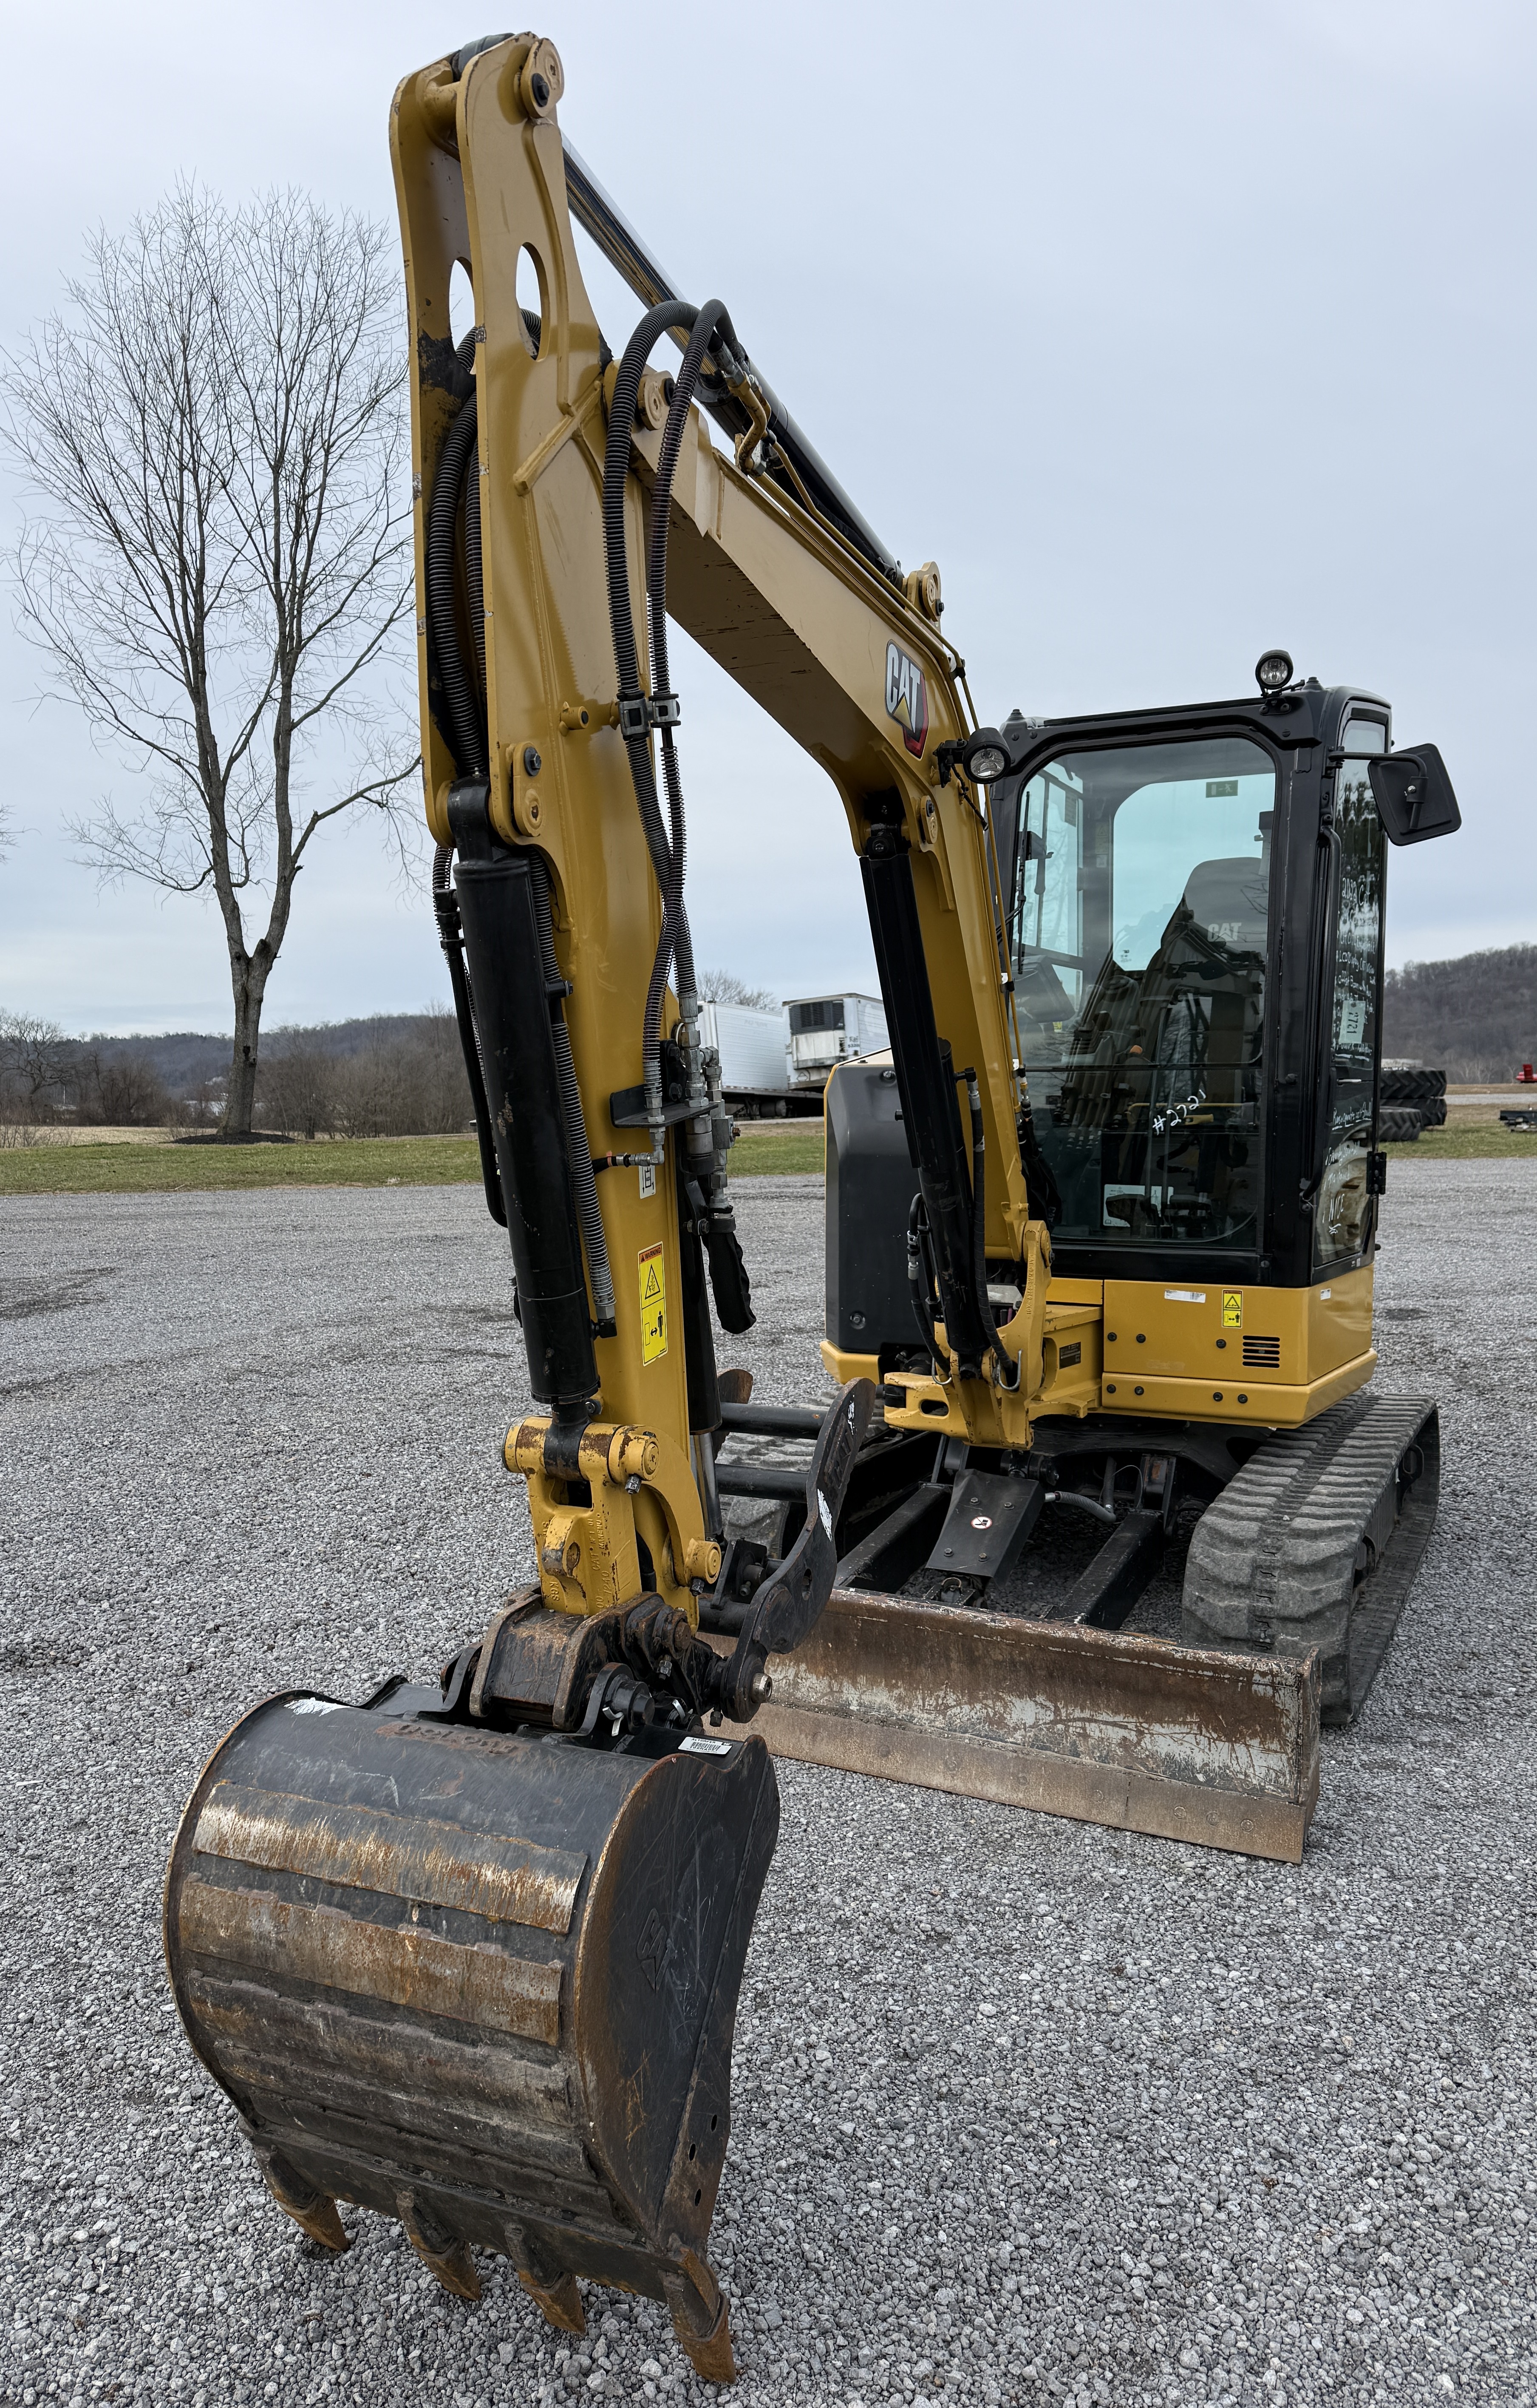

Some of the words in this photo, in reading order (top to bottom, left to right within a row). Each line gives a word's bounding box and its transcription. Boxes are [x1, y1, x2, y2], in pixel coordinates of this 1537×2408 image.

[886, 644, 920, 733] CAT
[1207, 922, 1242, 942] CAT
[1152, 1089, 1206, 1135] #2721
[591, 1552, 600, 1571] CAT
[549, 1581, 560, 1601] KGS
